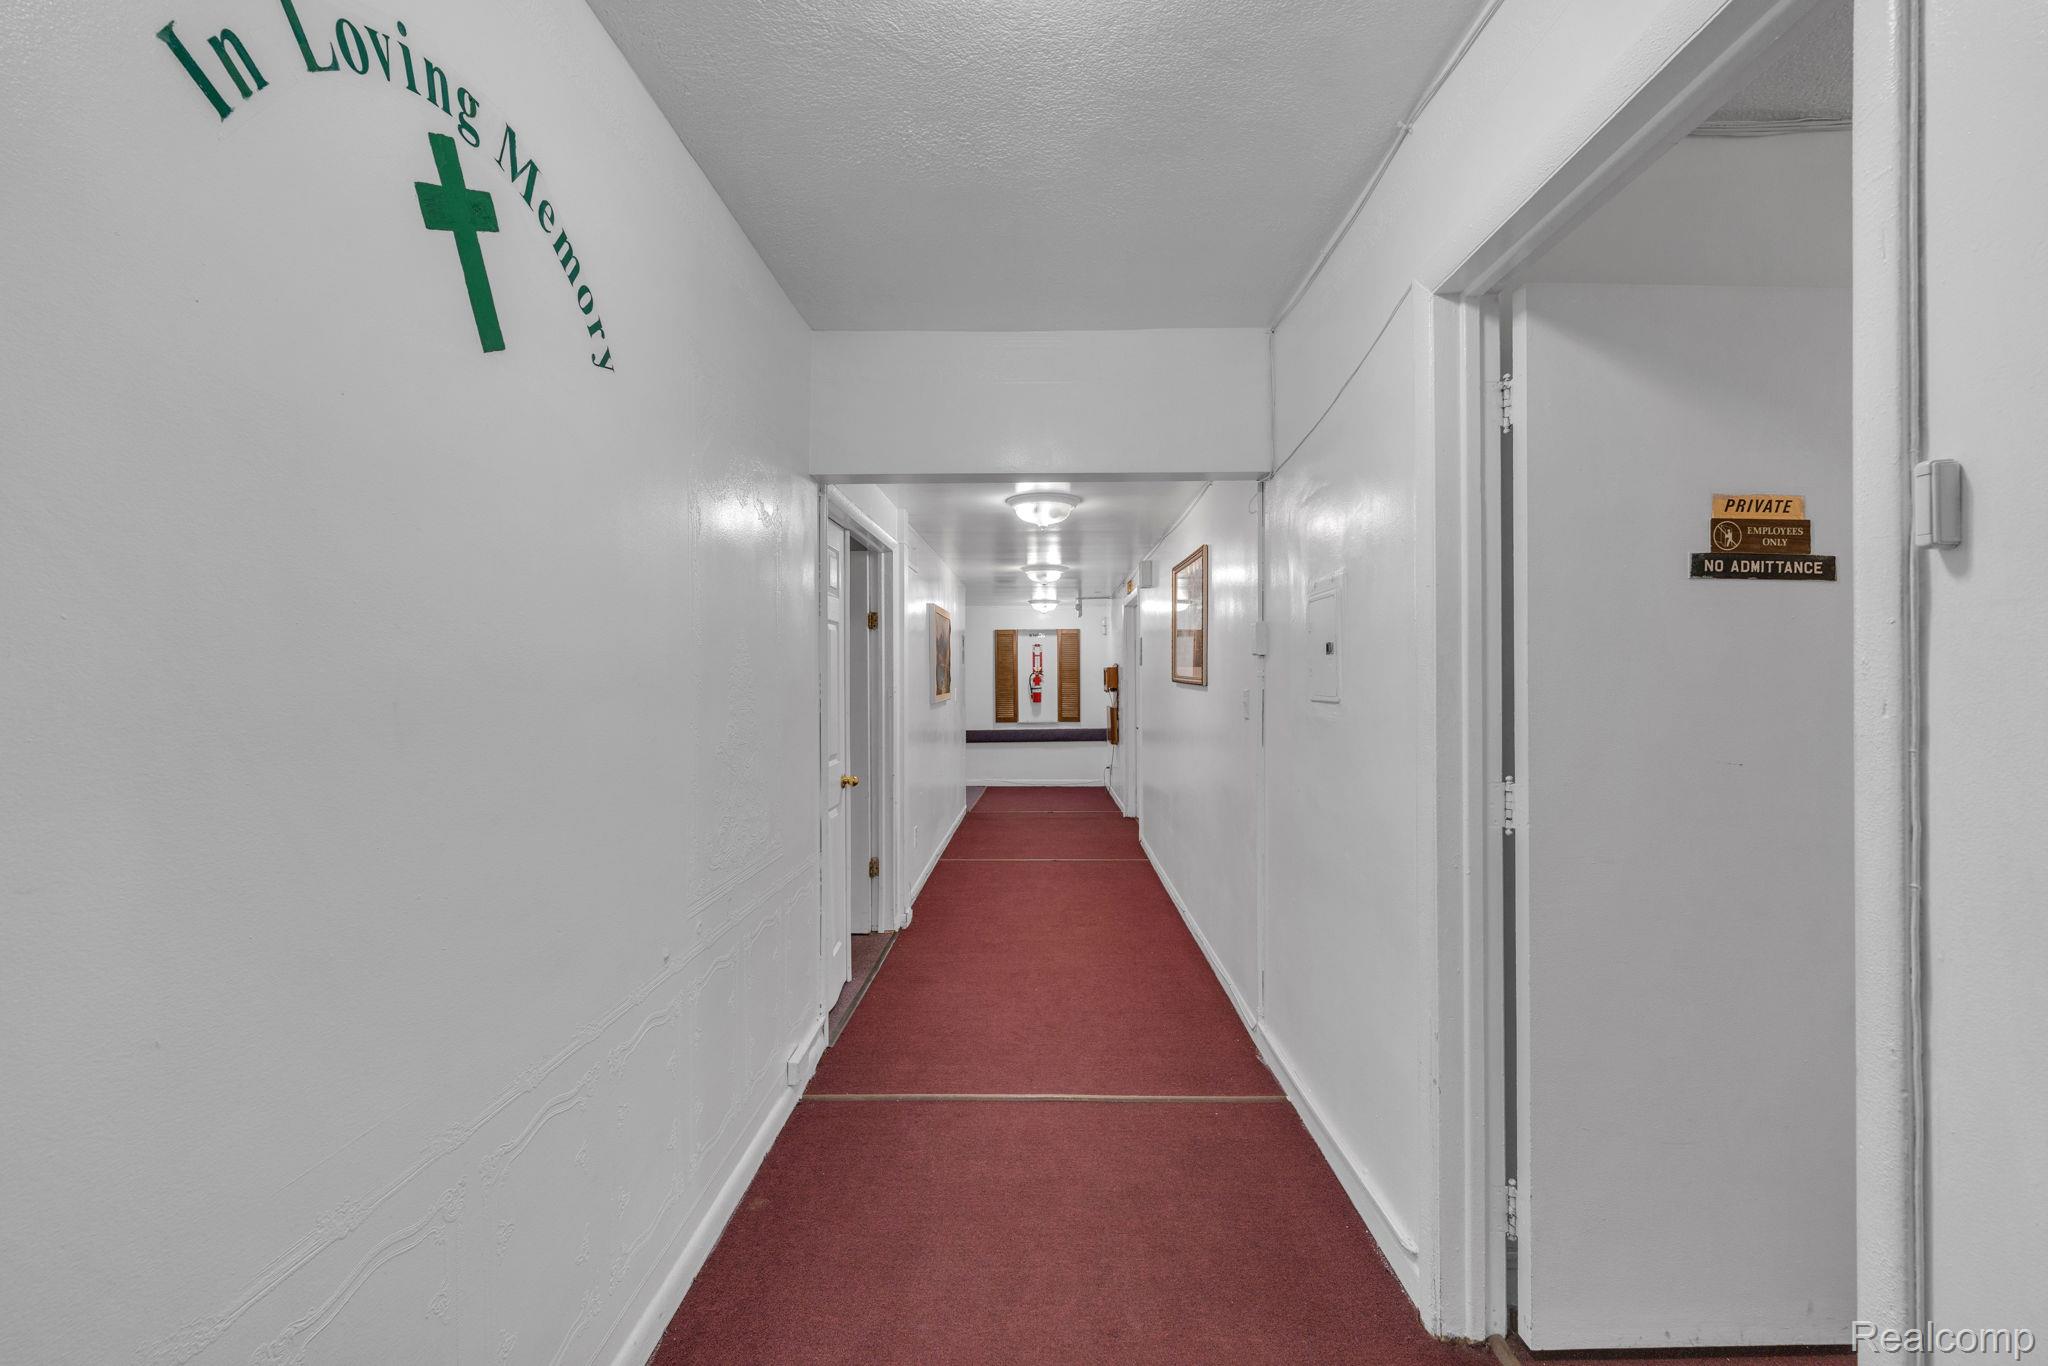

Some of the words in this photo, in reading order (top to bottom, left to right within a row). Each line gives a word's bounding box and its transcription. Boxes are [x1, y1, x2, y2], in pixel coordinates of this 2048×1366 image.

[156, 20, 269, 122] In
[280, 0, 480, 148] Loving
[494, 122, 615, 373] Memory
[1724, 498, 1793, 513] PRIVATE
[1747, 526, 1804, 536] EMPLOYEES
[1762, 537, 1788, 547] ONLY
[1704, 559, 1724, 573] NO
[1731, 560, 1823, 575] ADMITTANCE
